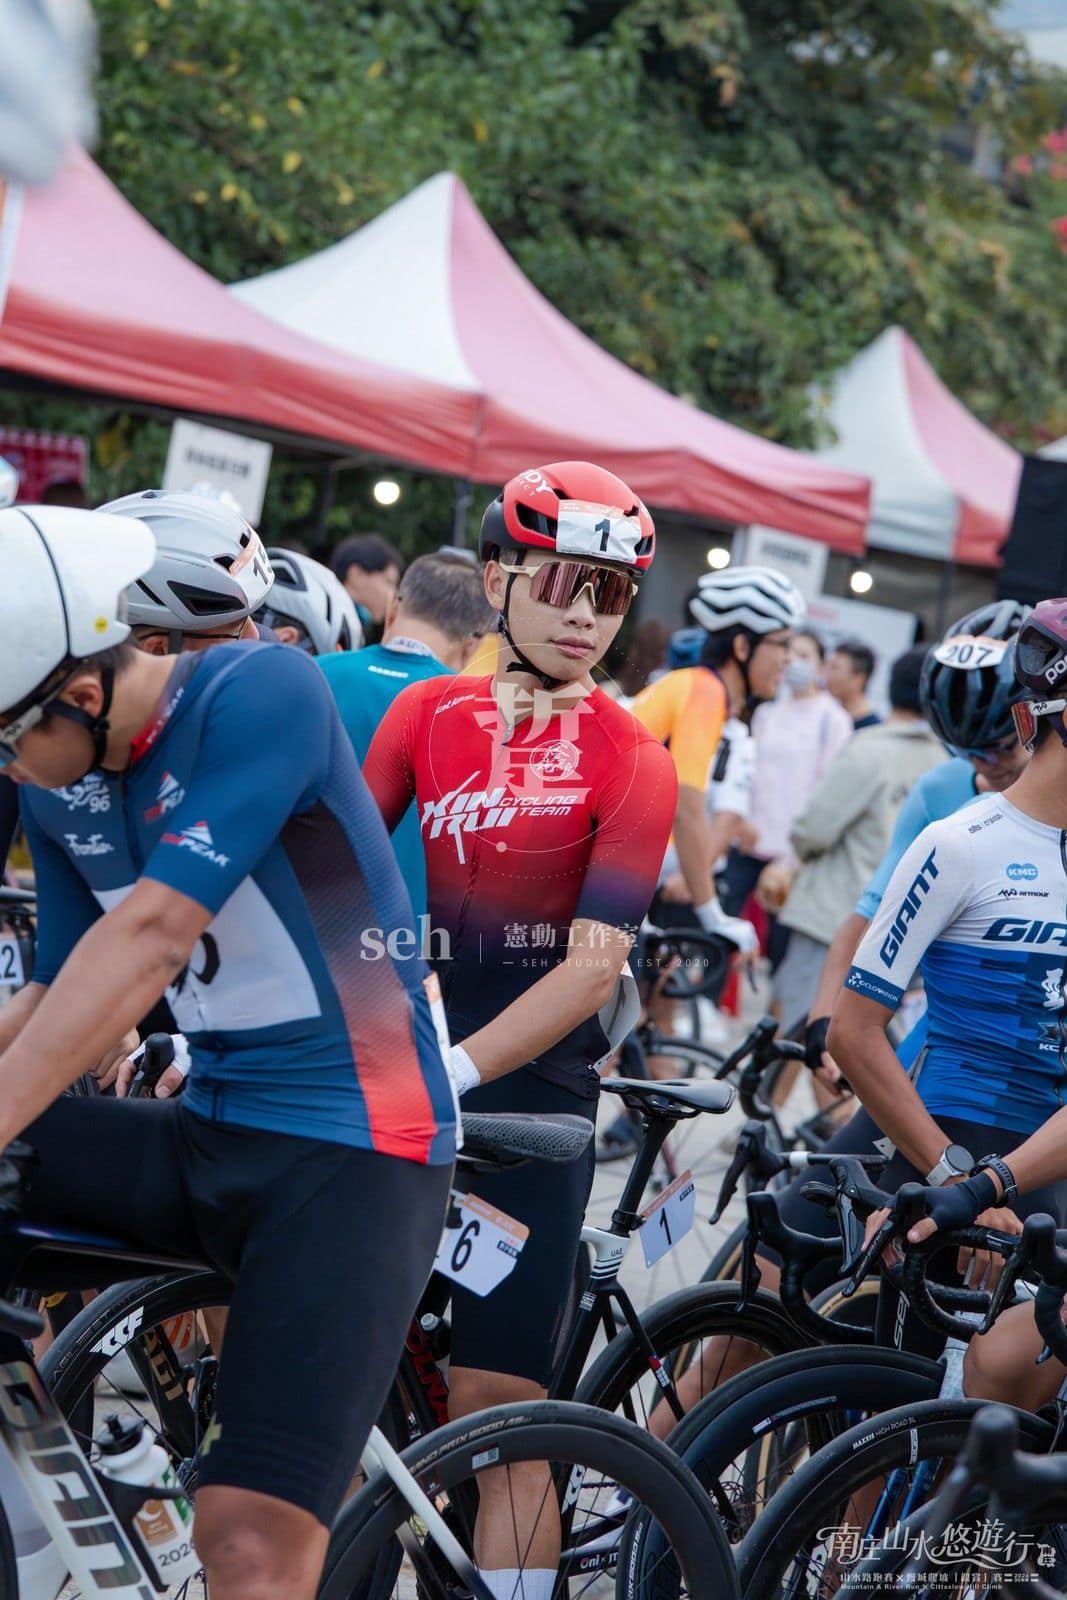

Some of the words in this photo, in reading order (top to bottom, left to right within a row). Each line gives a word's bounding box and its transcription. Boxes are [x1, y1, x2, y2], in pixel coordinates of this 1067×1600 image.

[594, 519, 611, 552] 1
[945, 644, 992, 664] 207
[1045, 655, 1067, 686] po
[500, 795, 578, 807] CYCLING
[520, 806, 572, 817] TEAM
[1007, 867, 1037, 876] KMC
[879, 846, 940, 970] GIANT
[0, 945, 16, 979] 2
[660, 1207, 672, 1245] 1
[451, 1219, 480, 1272] 6
[438, 1433, 469, 1455] PRIX
[468, 1421, 506, 1439] 5000
[852, 1432, 875, 1450] MAXXIS
[875, 1425, 891, 1437] HIGH
[891, 1418, 908, 1430] ROAD
